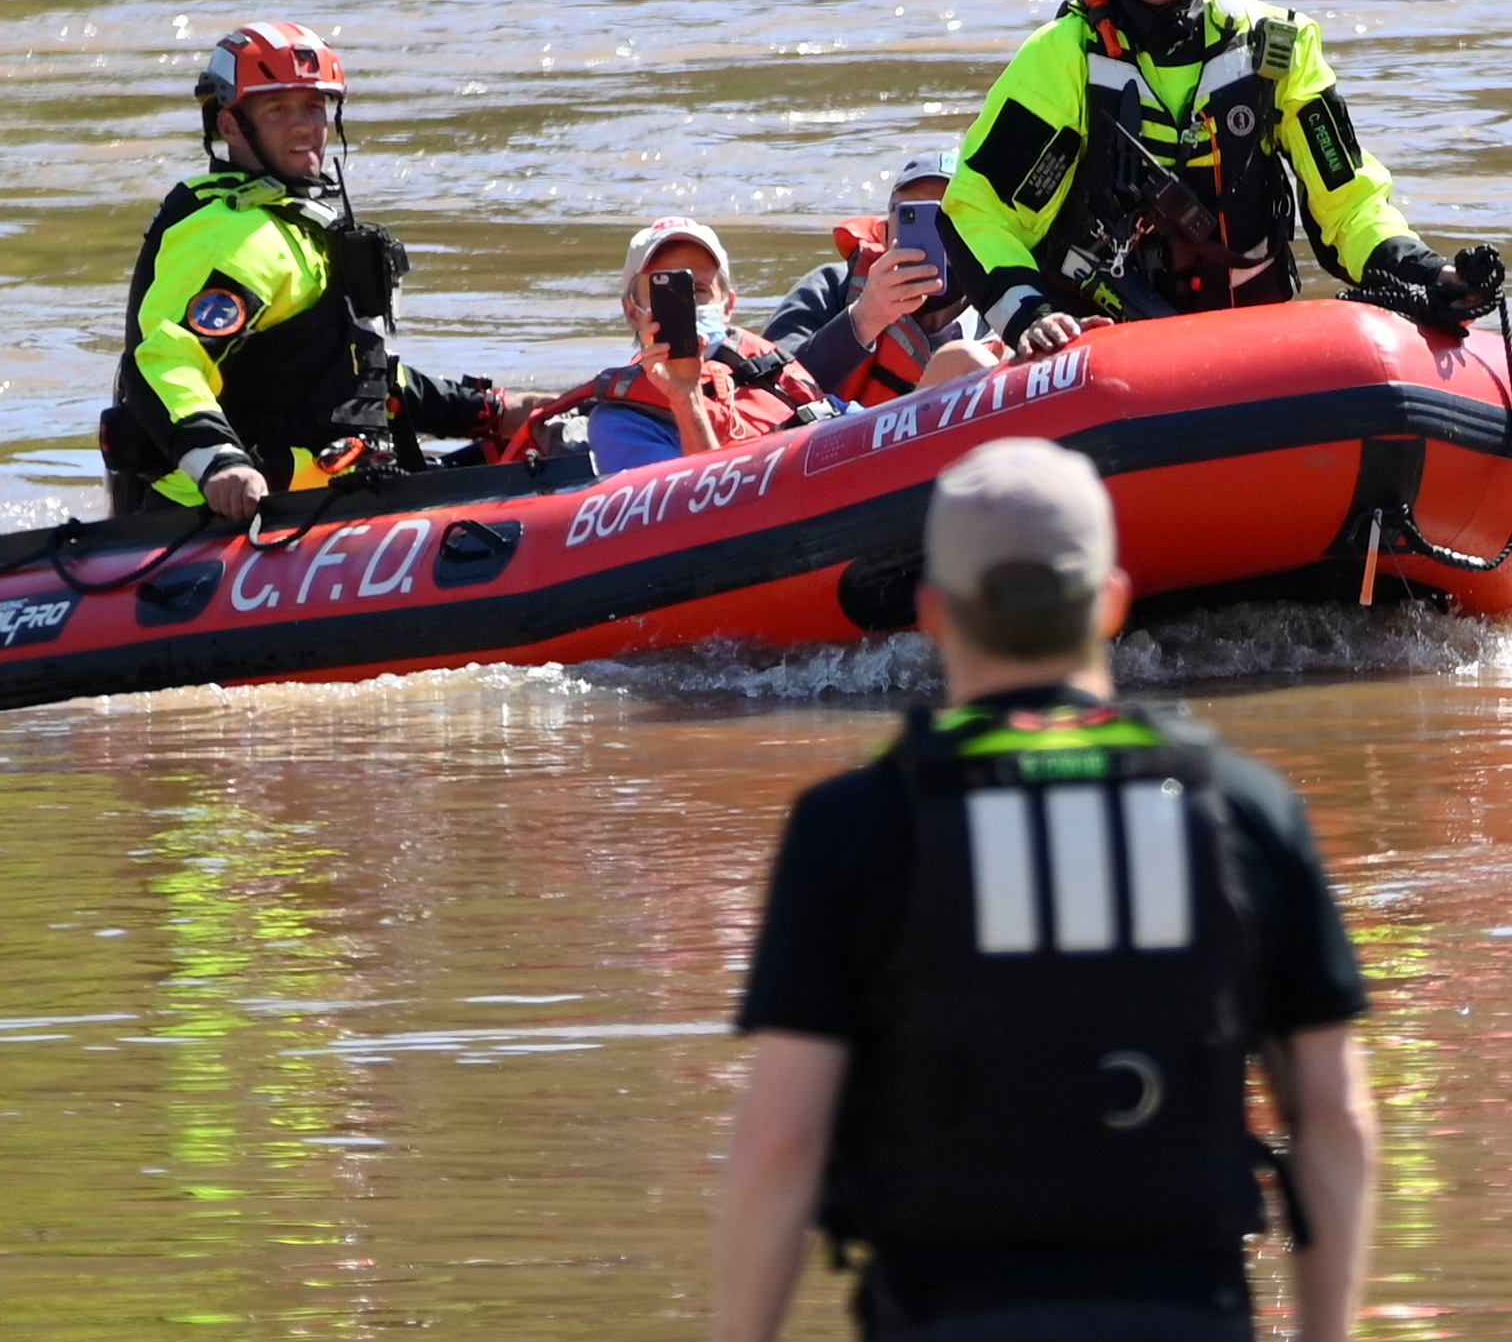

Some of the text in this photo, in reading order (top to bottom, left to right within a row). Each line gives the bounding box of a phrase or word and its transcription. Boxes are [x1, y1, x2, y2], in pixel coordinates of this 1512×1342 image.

[872, 403, 918, 449] PA
[937, 374, 1008, 428] 771
[1025, 350, 1081, 399] RU
[566, 447, 785, 547] BOAT 55-1
